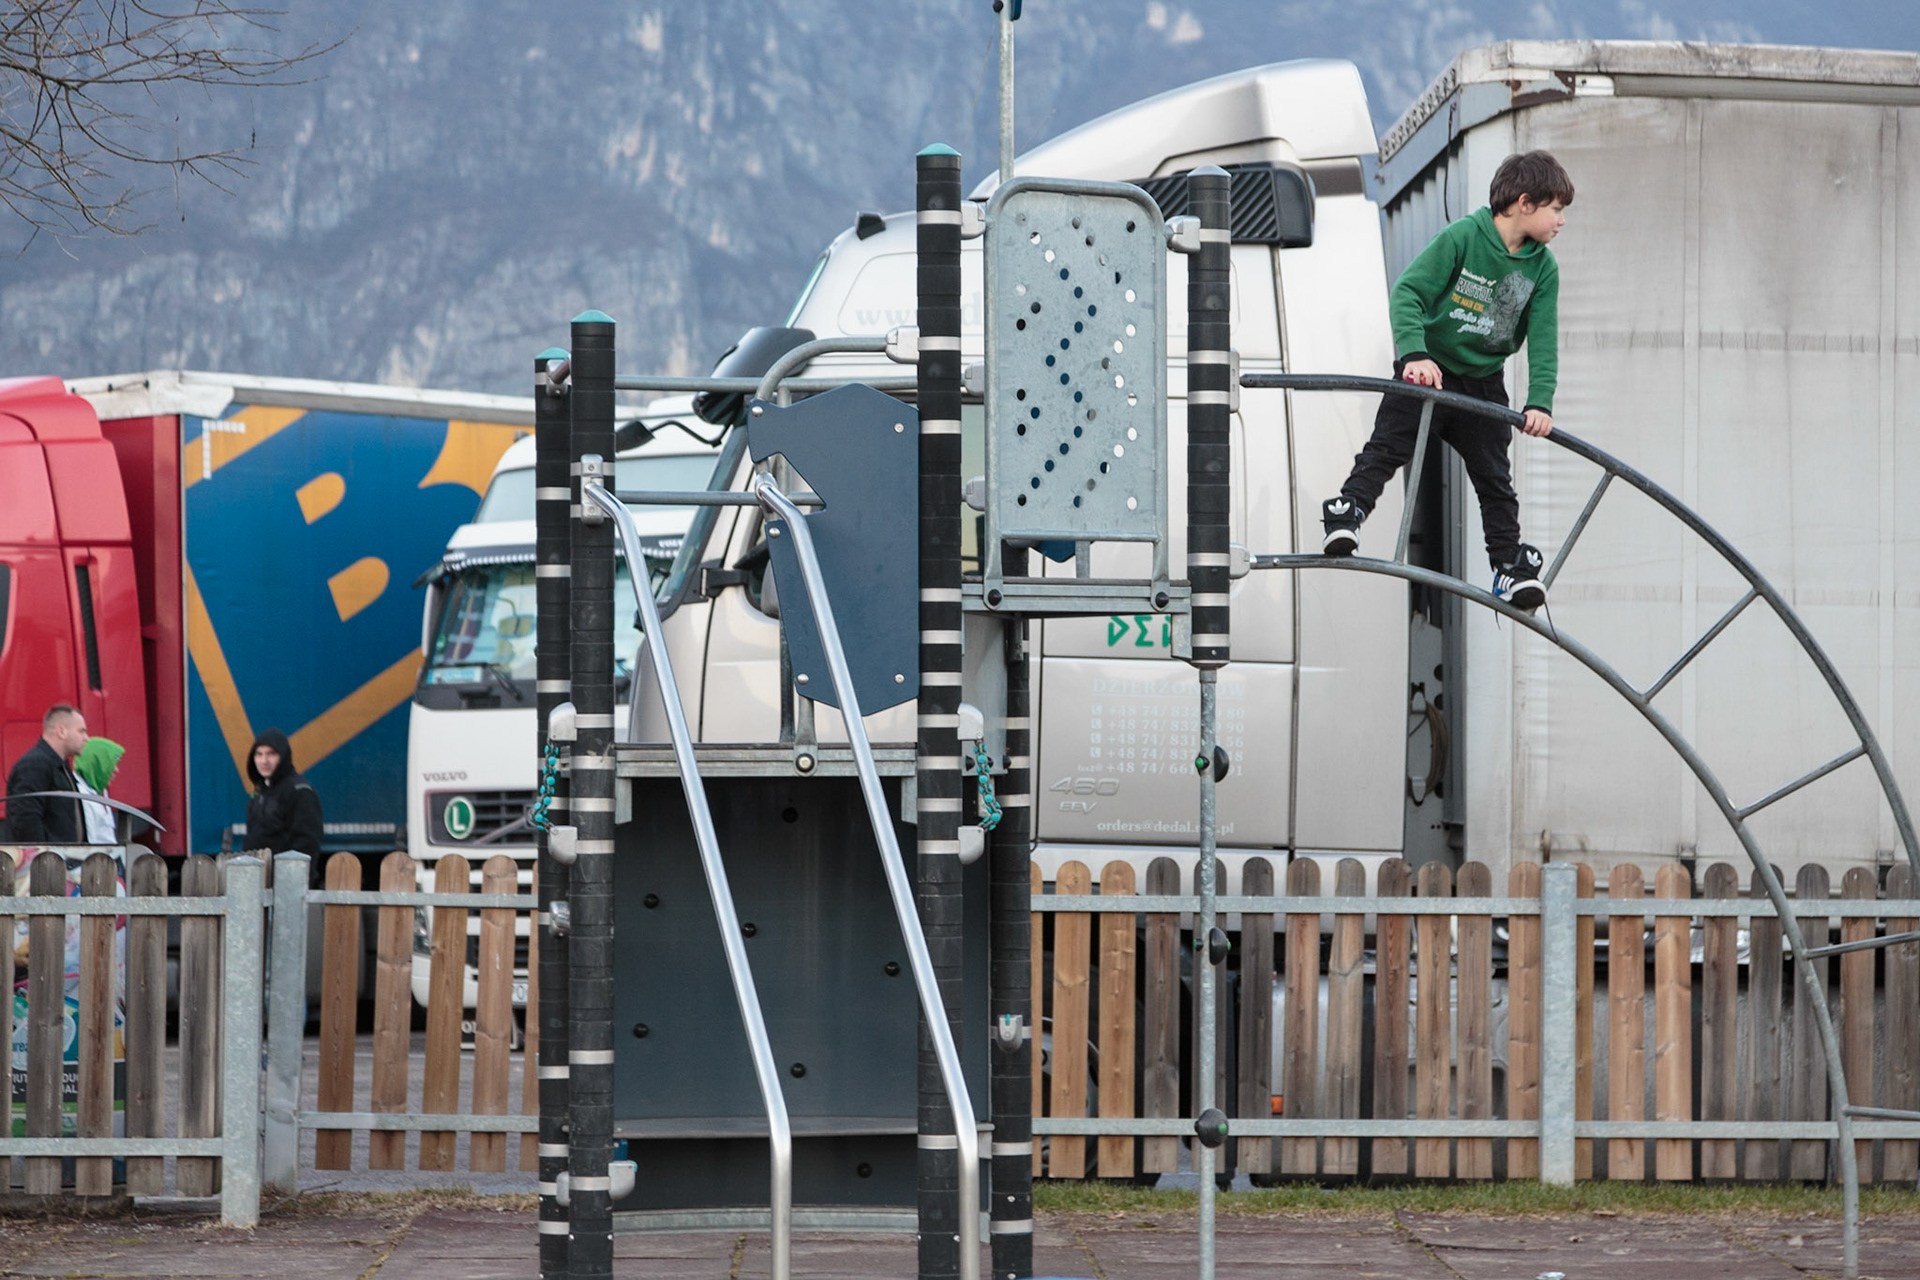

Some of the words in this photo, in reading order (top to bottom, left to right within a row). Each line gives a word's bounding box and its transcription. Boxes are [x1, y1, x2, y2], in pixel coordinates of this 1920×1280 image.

[423, 771, 467, 782] VOLVO
[1049, 776, 1120, 796] 460
[1059, 801, 1097, 815] EEV
[451, 805, 467, 832] L
